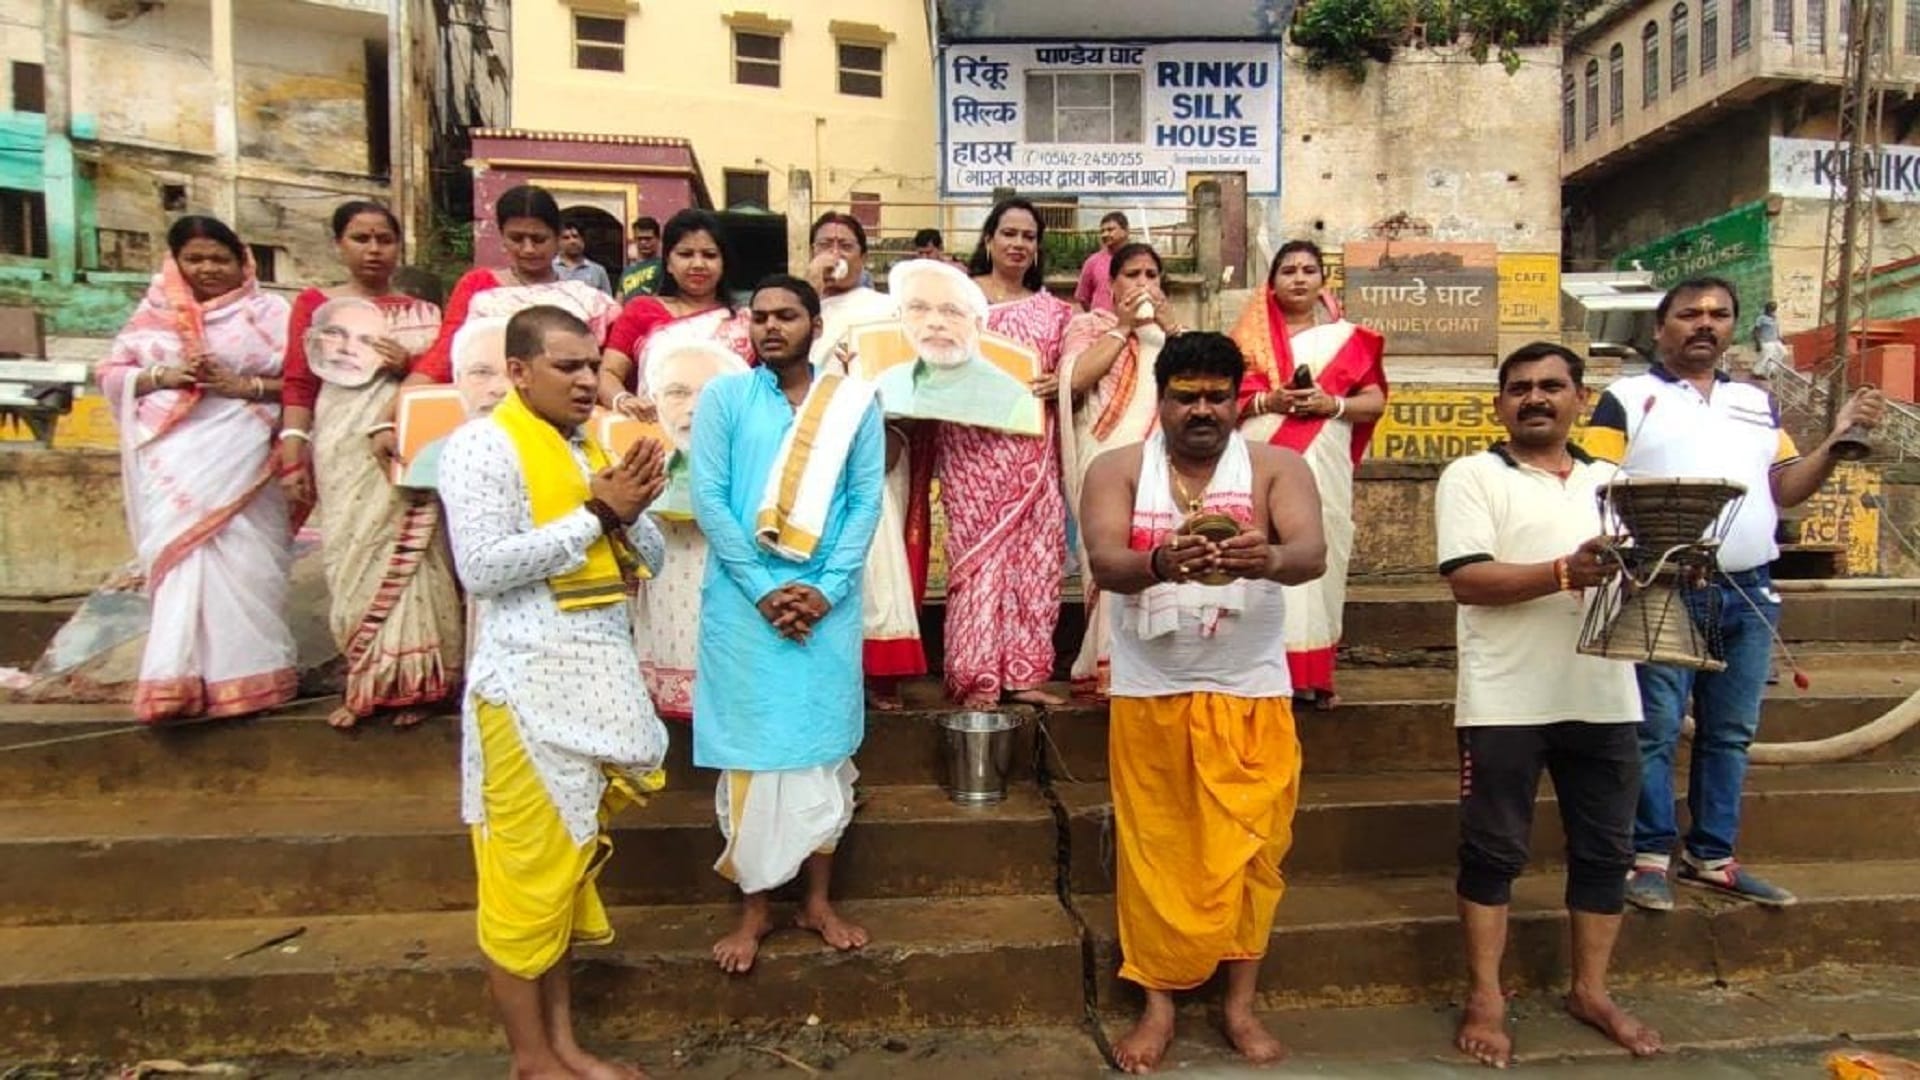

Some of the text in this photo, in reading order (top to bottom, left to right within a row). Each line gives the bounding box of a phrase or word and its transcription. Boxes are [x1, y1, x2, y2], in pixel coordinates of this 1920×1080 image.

[1036, 46, 1146, 65] पाण्डेय घाट
[1157, 61, 1268, 88] RINKU
[952, 96, 1017, 127] सिल्क
[1173, 94, 1243, 119] SILK
[1157, 125, 1257, 147] HOUSE
[952, 141, 1016, 166] हाउस
[1007, 170, 1052, 187] सरकार
[1513, 272, 1548, 282] CAFE
[1360, 278, 1428, 307] पाण्डे
[1434, 285, 1483, 307] घाट
[1436, 317, 1480, 333] GHAT
